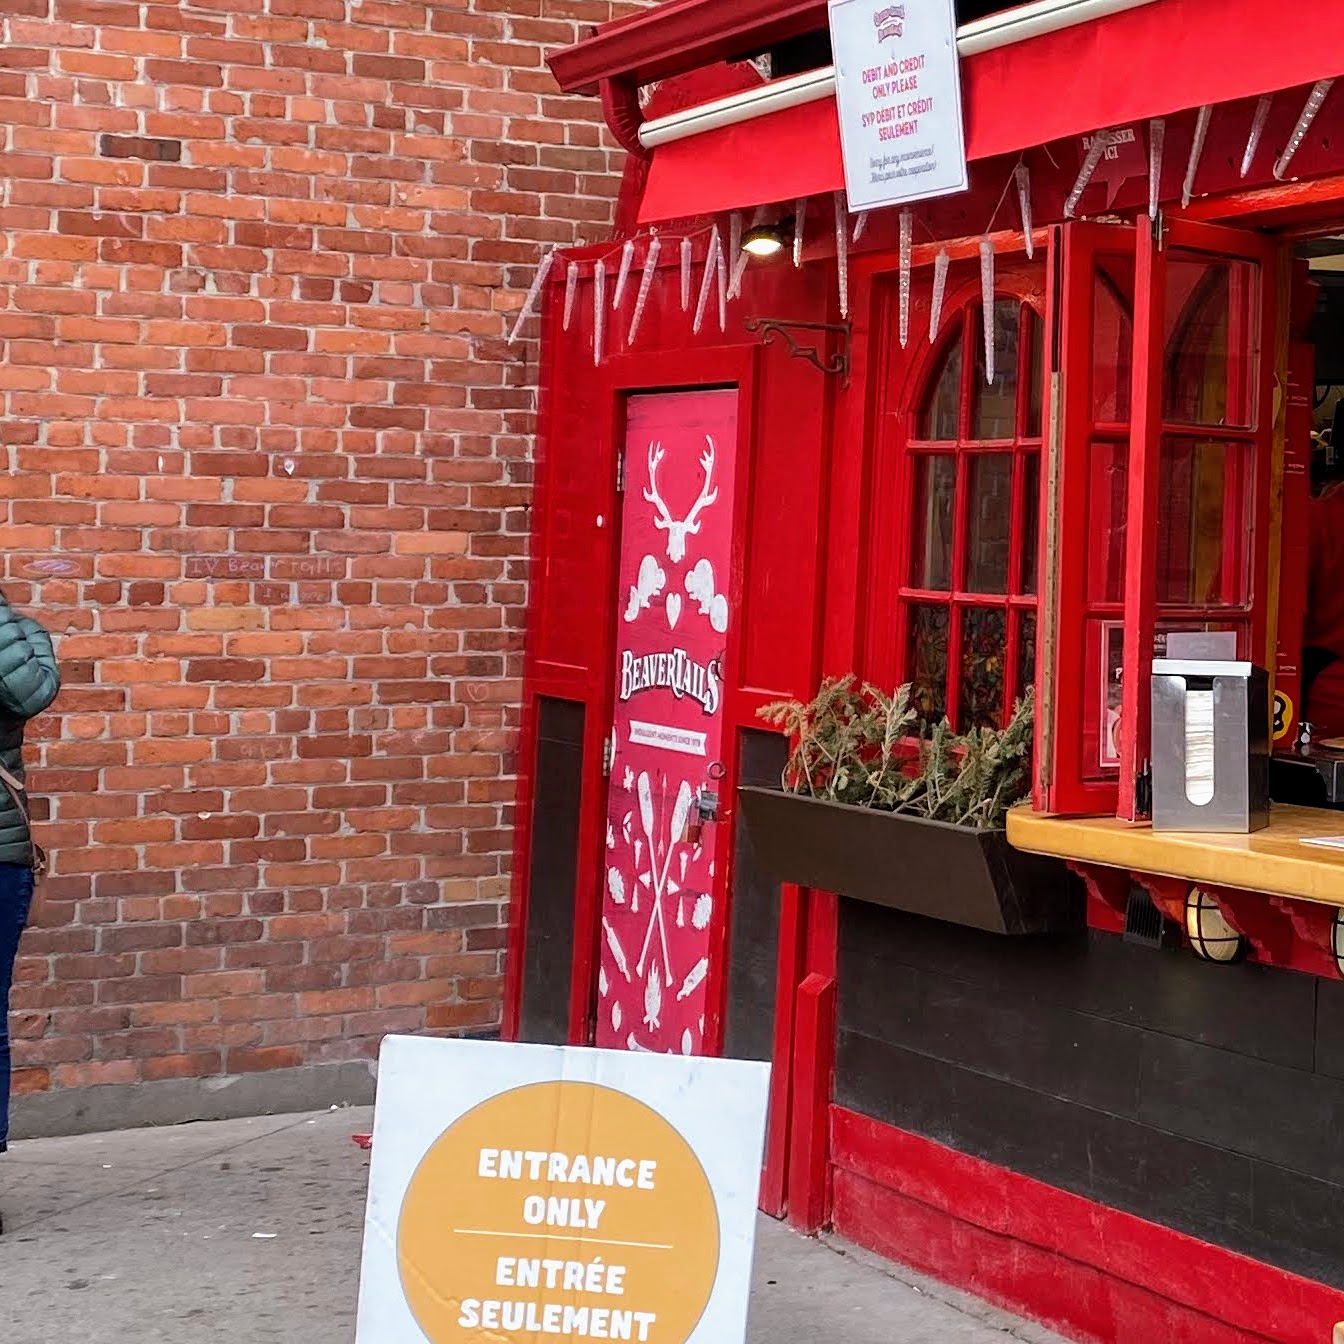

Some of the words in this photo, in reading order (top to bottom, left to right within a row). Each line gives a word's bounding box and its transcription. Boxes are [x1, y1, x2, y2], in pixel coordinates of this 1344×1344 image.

[862, 66, 882, 85] DEBIT
[883, 62, 899, 79] AND
[899, 54, 926, 74] CREDIT
[872, 82, 891, 99] ONLY
[892, 75, 918, 95] PLEASE
[878, 120, 919, 142] SEULEMENT
[620, 647, 719, 714] BEAVERTAILS
[477, 1148, 657, 1190] ENTRANCE
[522, 1195, 606, 1230] ONLY
[495, 1256, 627, 1295] ENTRÉE
[457, 1298, 657, 1343] SEULEMENT
